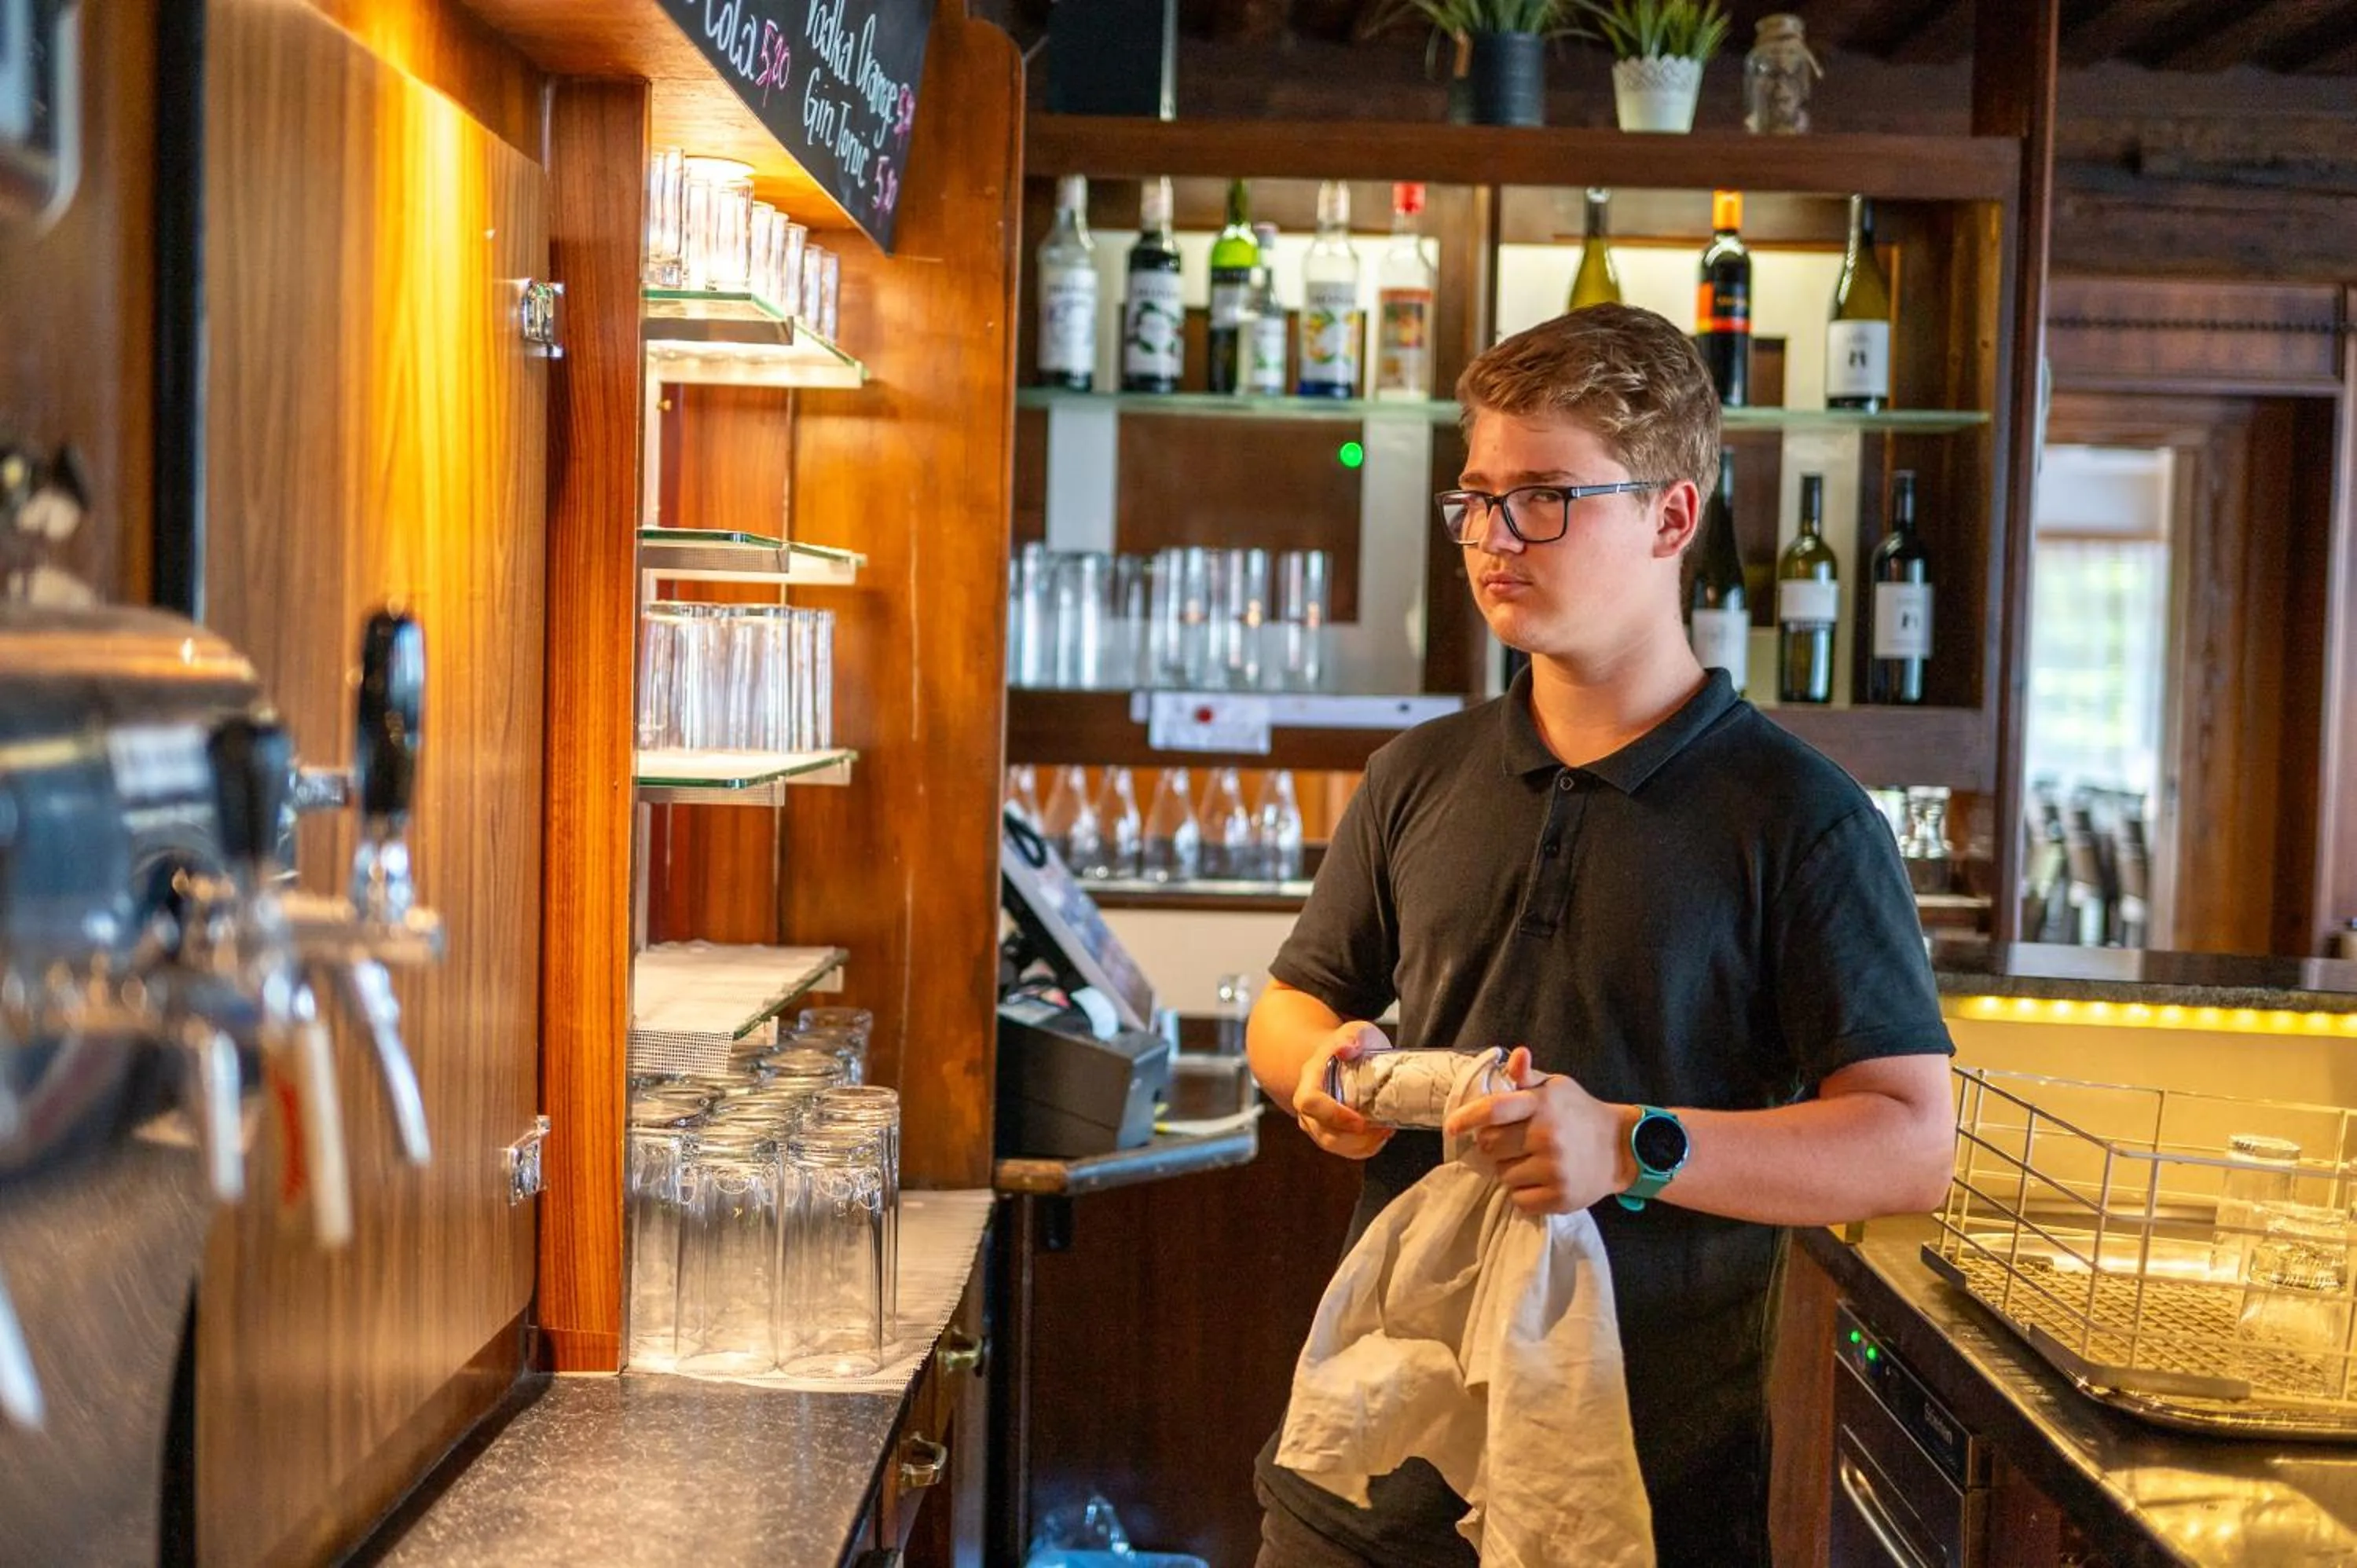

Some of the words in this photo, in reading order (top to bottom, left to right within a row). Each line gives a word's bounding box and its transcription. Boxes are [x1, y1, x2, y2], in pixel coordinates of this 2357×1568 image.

[804, 67, 834, 148] Gin
[834, 101, 870, 189] Tonic
[856, 13, 898, 149] Orange
